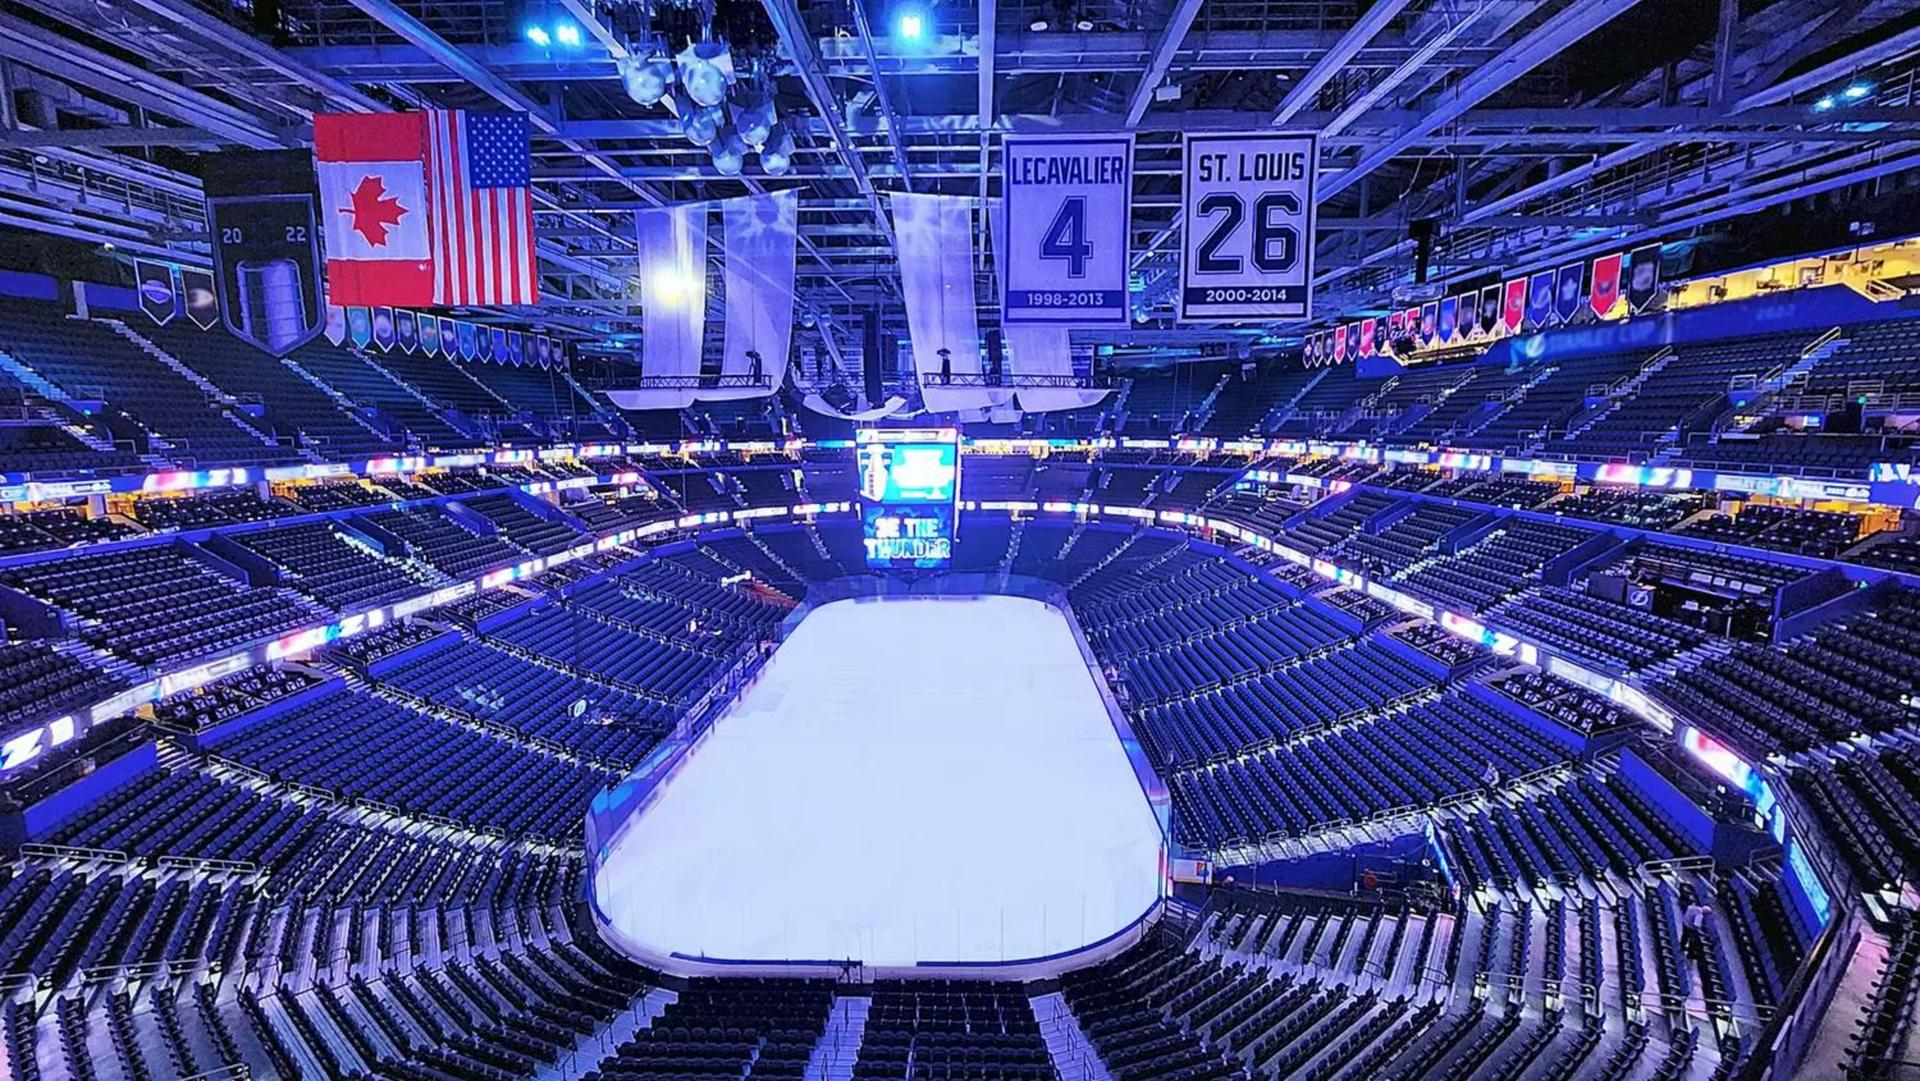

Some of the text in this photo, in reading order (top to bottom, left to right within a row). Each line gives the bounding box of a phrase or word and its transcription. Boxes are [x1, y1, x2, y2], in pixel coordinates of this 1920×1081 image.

[1012, 156, 1124, 185] LECAVALIER
[1199, 152, 1305, 182] ST. LOUIS
[222, 226, 306, 244] 20 22
[1039, 195, 1093, 279] 4
[1195, 191, 1302, 275] 26
[1027, 292, 1104, 306] 1998-2013
[1206, 289, 1287, 302] 2000-2014
[904, 517, 939, 537] THE
[863, 538, 951, 559] THUNDER
